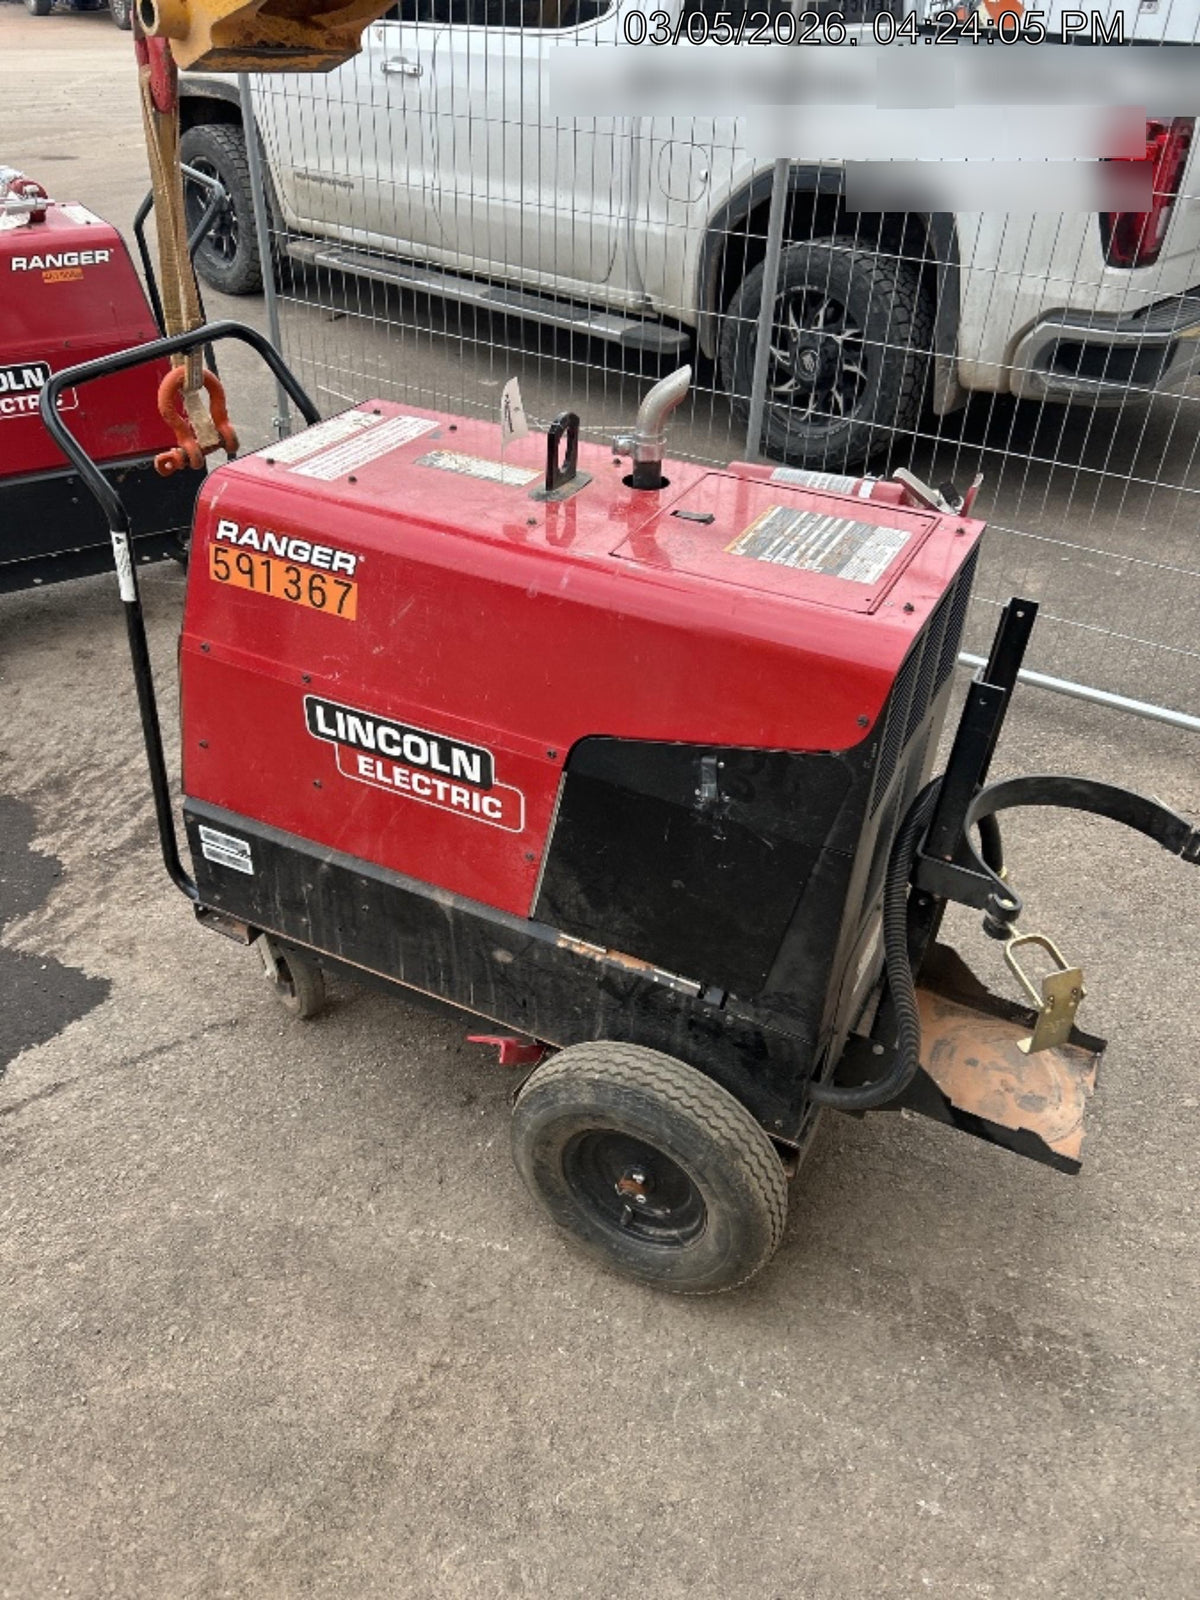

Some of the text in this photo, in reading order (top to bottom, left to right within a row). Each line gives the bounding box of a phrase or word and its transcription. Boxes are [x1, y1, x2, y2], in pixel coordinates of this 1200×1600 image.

[11, 249, 110, 271] RANGER
[215, 518, 357, 575] RANGER
[213, 546, 353, 614] 591367
[315, 704, 481, 783] LINCOLN
[356, 754, 503, 819] ELECTRIC
